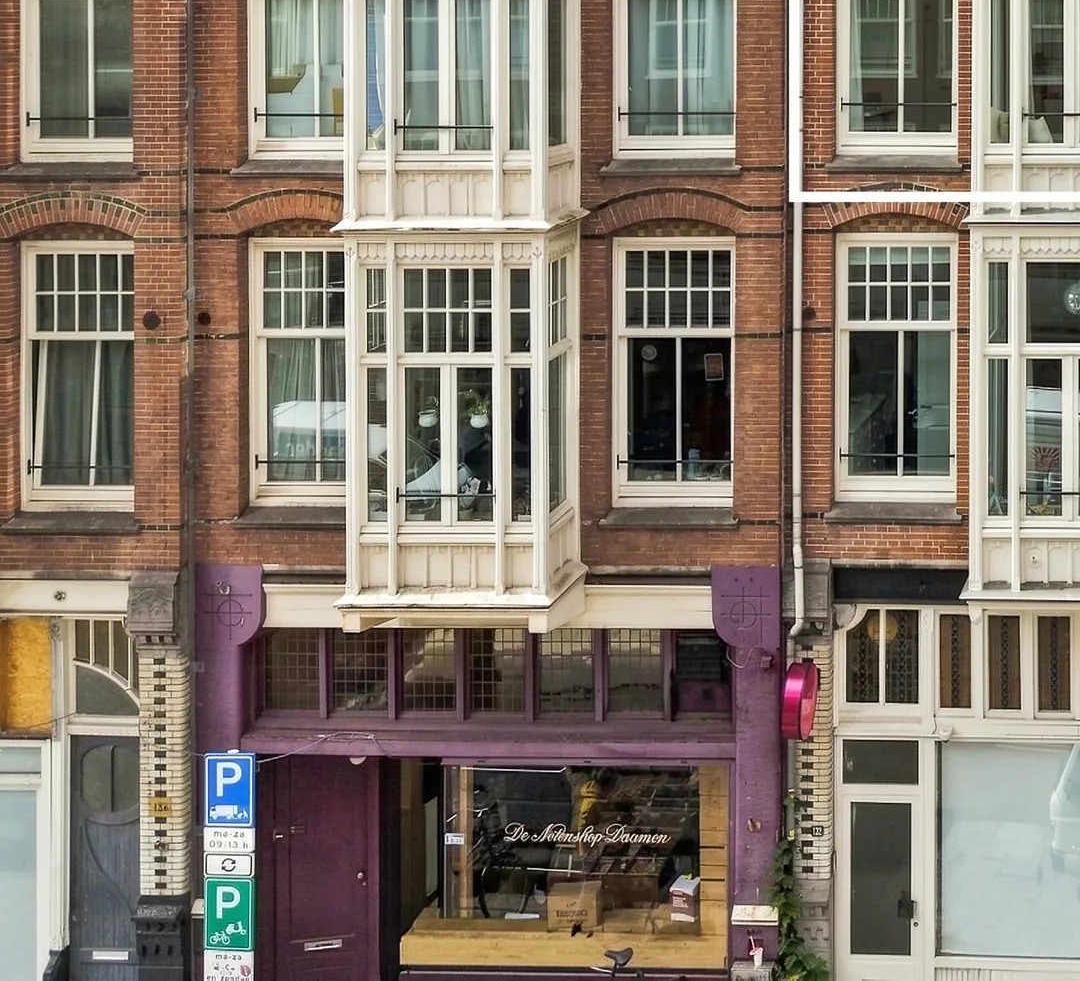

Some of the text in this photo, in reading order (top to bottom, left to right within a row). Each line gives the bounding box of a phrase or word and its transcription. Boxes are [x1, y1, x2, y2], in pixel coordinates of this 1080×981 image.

[216, 762, 242, 797] P
[242, 841, 248, 849] h
[504, 822, 671, 847] De Notenshop Daamen
[216, 886, 241, 919] P
